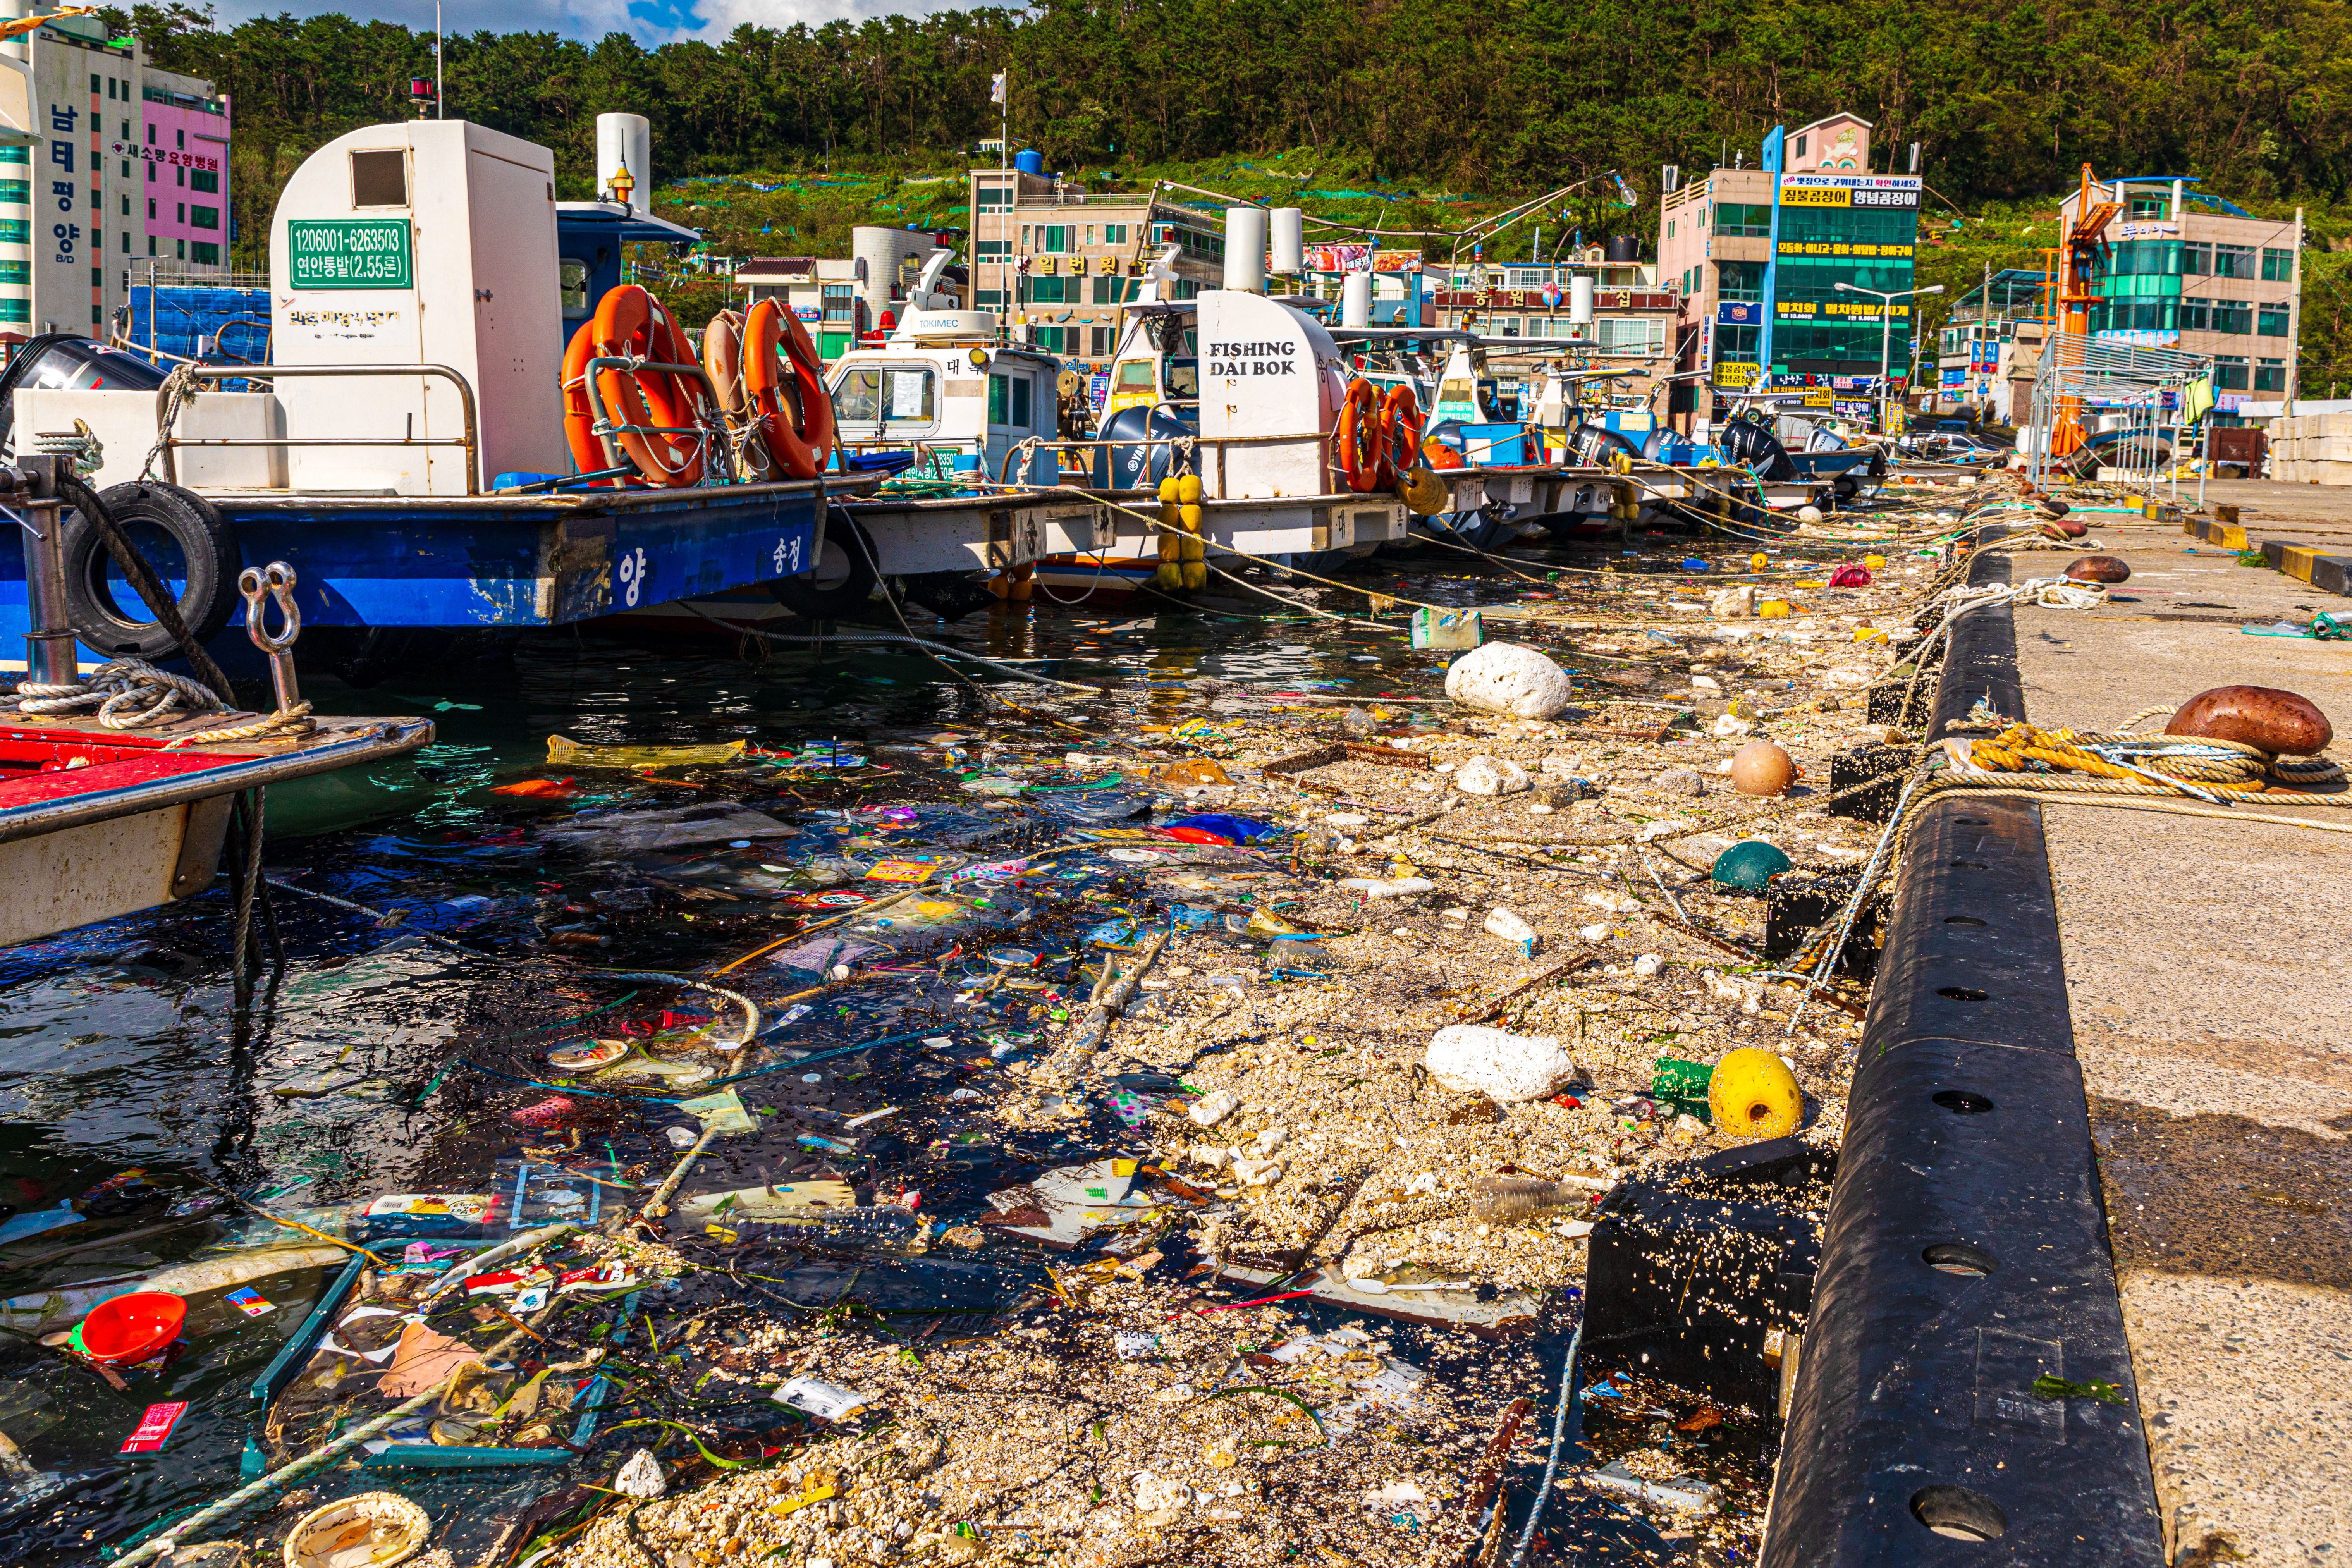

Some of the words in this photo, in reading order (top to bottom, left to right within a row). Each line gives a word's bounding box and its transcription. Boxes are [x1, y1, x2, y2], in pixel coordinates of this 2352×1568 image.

[127, 144, 166, 162] 새소망
[169, 151, 218, 172] 요양병원
[52, 104, 80, 253] 남태평양
[1876, 179, 1919, 187] 확인하세요.
[1854, 191, 1917, 205] 양념곰장어
[296, 229, 399, 251] 1206001-6263503
[56, 254, 74, 263] B/D
[297, 256, 401, 278] 연안통발(2.55톤)
[1777, 302, 1817, 313] 멸치회
[920, 320, 959, 328] TOKIMEC
[1209, 342, 1295, 357] FISHING
[947, 359, 959, 375] 대
[1066, 358, 1112, 373] 일번횟집
[1210, 362, 1247, 376] DAI
[1252, 361, 1296, 375] BOK
[1131, 428, 1159, 461] YAMA
[1818, 436, 1828, 448] NDA
[1575, 436, 1594, 467] UZUKI
[773, 536, 801, 573] 송정
[620, 547, 646, 607] 양
